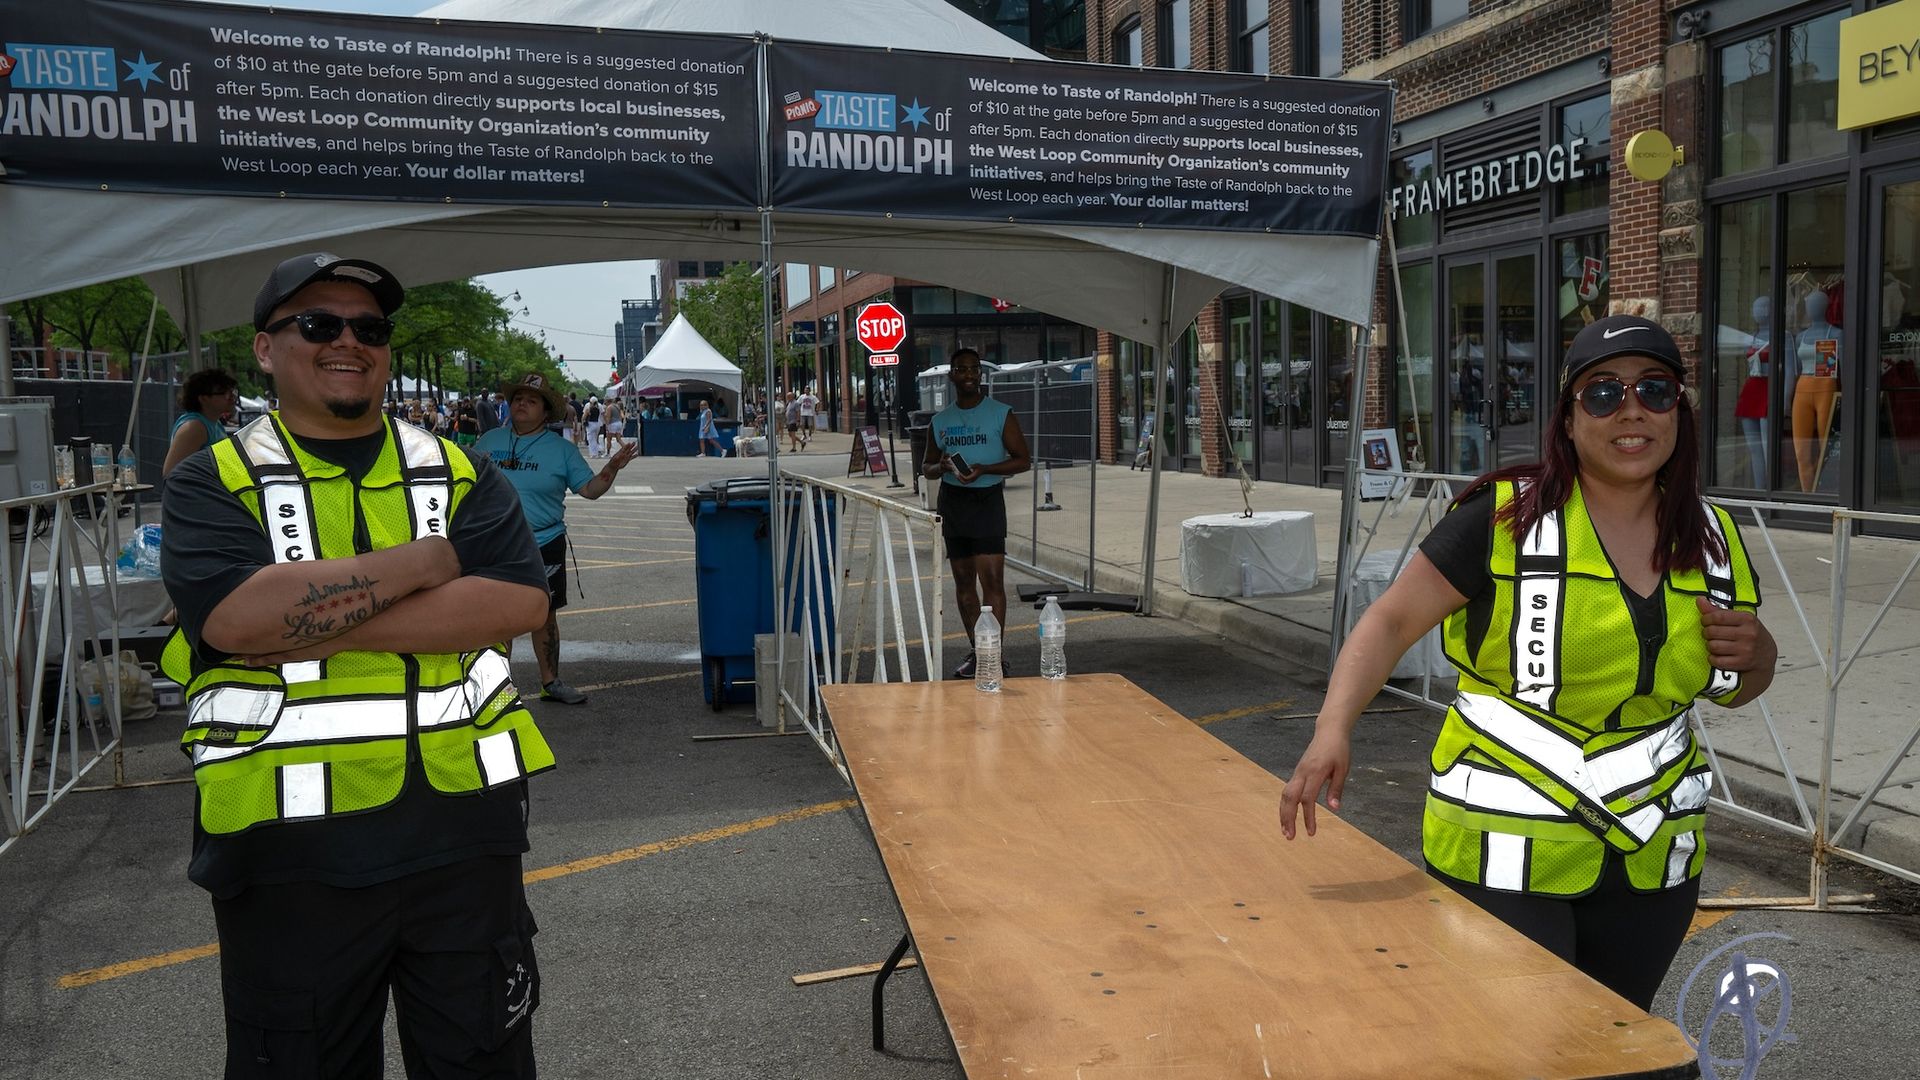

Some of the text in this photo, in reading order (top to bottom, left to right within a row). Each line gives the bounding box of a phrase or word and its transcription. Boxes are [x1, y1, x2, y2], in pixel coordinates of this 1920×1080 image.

[14, 47, 110, 88] TASTE
[169, 62, 191, 92] of
[210, 26, 745, 75] Welcome to Taste of Randolph! There is a suggested donation
[1858, 38, 1920, 85] BEY
[214, 54, 718, 97] of $10 at the gate before 5pm and a suggested donation of $15
[216, 80, 726, 122] after 5pm. Each donation directly supports local businesses,
[821, 93, 890, 129] TASTE
[935, 107, 952, 132] of
[968, 77, 1380, 117] Welcome to Taste of Randolph! There is a suggested donation
[0, 93, 198, 144] ANDOLPH
[217, 105, 710, 145] the West Loop Community Organization’s community
[969, 99, 1358, 137] of $10 at the gate before 5pm and a suggested donation of $15
[220, 129, 714, 165] initiatives, and helps bring the Taste of Randolph back to the
[787, 131, 953, 176] RANDOLPH
[969, 122, 1363, 159] after 5pm. Each donation directly supports local businesses,
[221, 156, 585, 184] West Loop each year. Your dollar matters!
[969, 143, 1350, 179] the West Loop Community Organization’s community
[970, 163, 1353, 197] initiatives, and helps bring the Taste of Randolph back to the
[1391, 136, 1586, 220] FRAMEBRIDGE
[970, 187, 1249, 212] West Loop each year. Your dollar matters!
[861, 318, 902, 339] STOP
[885, 356, 897, 364] WAY
[281, 611, 336, 640] Love
[344, 607, 367, 625] no
